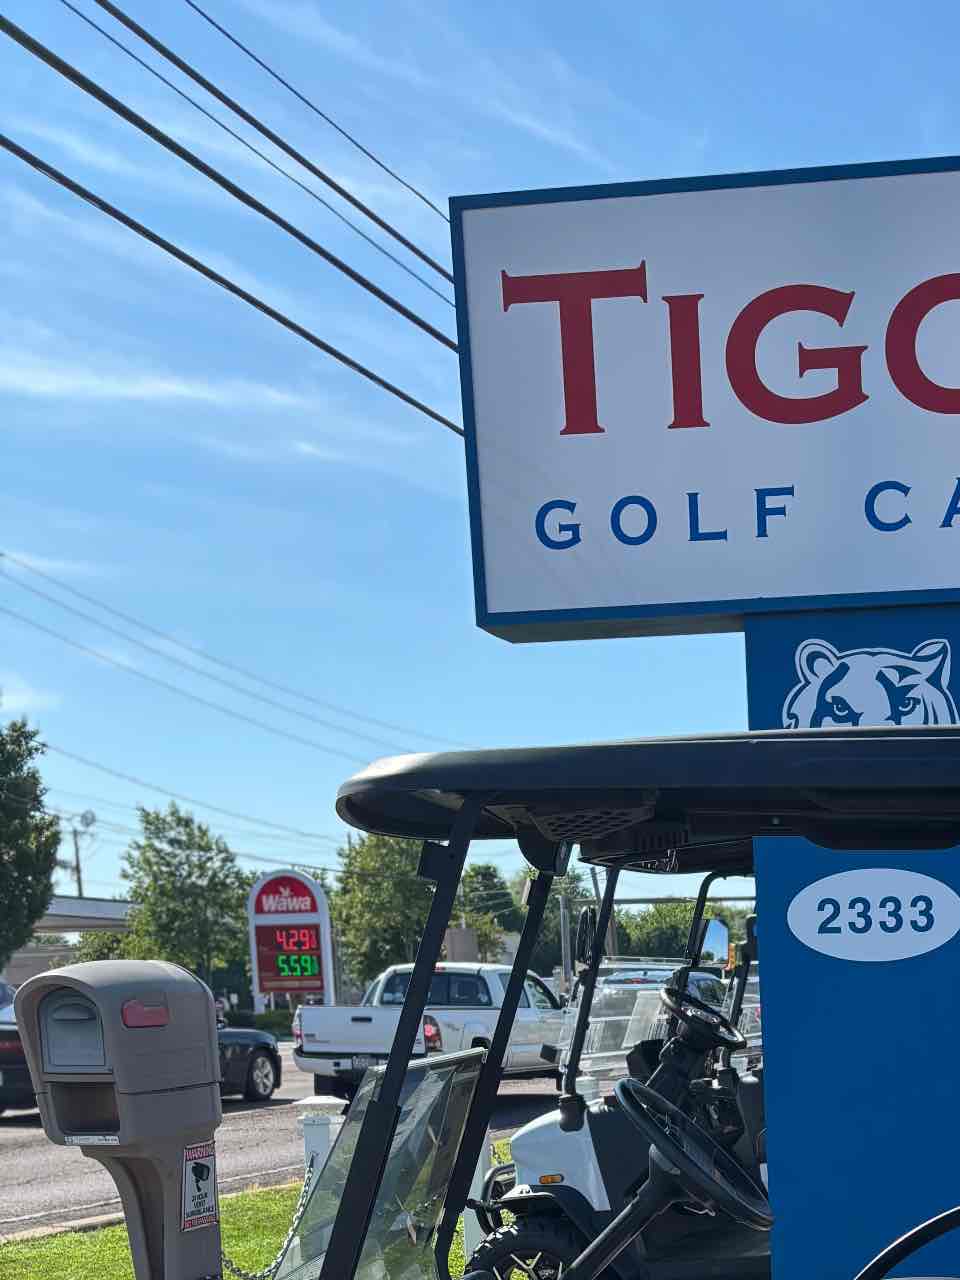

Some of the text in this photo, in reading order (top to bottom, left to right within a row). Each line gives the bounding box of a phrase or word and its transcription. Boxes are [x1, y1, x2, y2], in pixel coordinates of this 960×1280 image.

[535, 485, 795, 550] GOLF
[262, 895, 311, 912] Wawa
[817, 895, 935, 934] 2333
